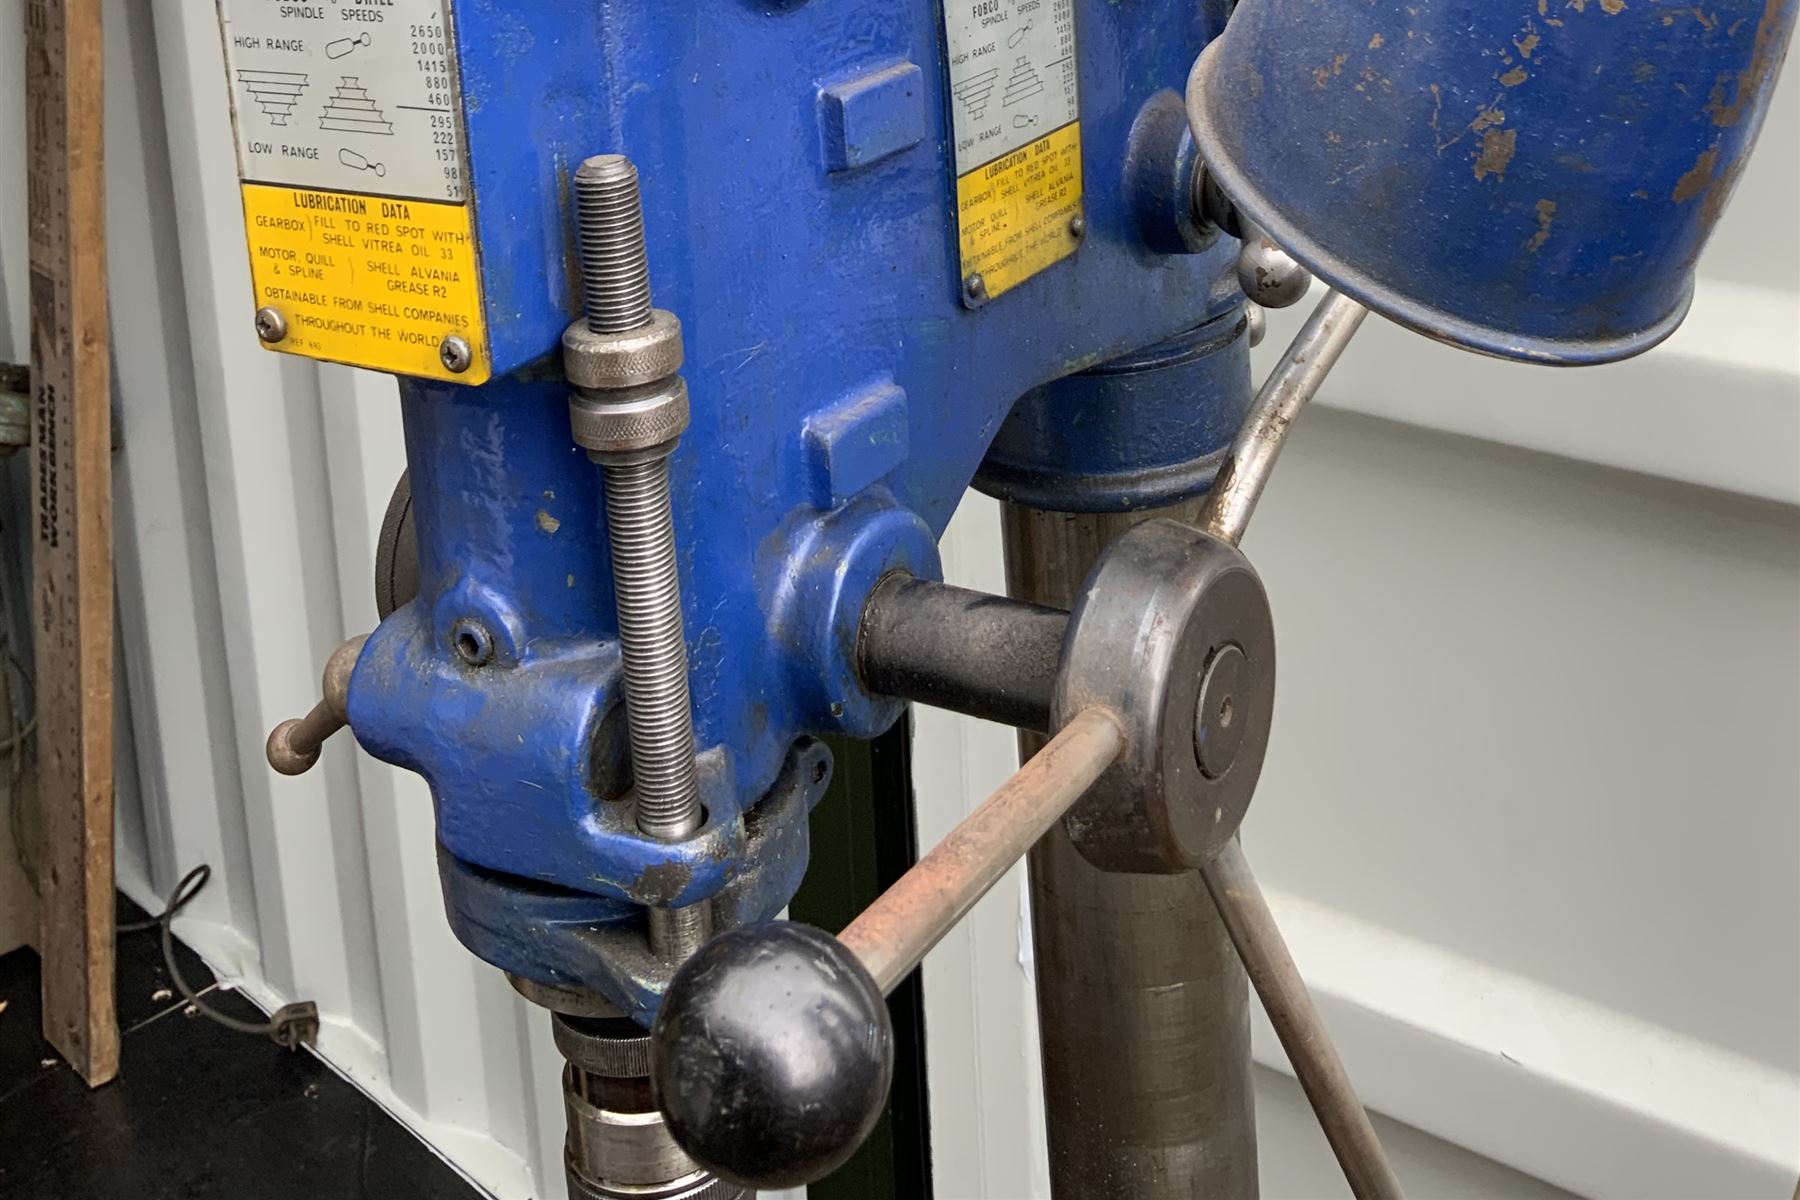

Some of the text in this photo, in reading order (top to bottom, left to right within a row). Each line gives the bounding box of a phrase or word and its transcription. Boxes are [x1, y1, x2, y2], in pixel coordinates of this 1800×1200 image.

[280, 6, 384, 22] SPINDLE SPEEDS
[973, 0, 999, 19] FOBCO
[982, 0, 1040, 28] SPINDLE SPEEDS
[410, 25, 442, 38] 2650
[234, 36, 304, 52] HIGH RANGE
[412, 42, 444, 55] 2000
[952, 42, 996, 66] HIGH RANGE
[417, 60, 446, 73] 1415
[426, 76, 448, 89] 880
[428, 93, 450, 106] 460
[430, 116, 452, 129] 295
[433, 132, 454, 145] 222
[959, 124, 1002, 152] LOW RANGE
[248, 142, 320, 160] LOW RANGE
[436, 148, 456, 161] 157
[985, 139, 1050, 180] LUBRICATION DATA
[444, 167, 458, 179] 98
[996, 176, 1009, 188] FILL
[1015, 168, 1023, 179] TO
[1026, 161, 1039, 173] RED
[446, 185, 459, 197] 51
[293, 192, 411, 220] LUBRICATION DATA
[255, 215, 464, 245] GEARBOX FILL TO RED SPOT WITH
[323, 233, 453, 260] SHELL VITREA OIL 33
[306, 252, 335, 267] QUILL
[273, 263, 324, 280] & SPLINE
[367, 261, 461, 283] SHELL ALVANIA
[387, 280, 447, 299] GREASE R2
[265, 286, 469, 328] OBTAINABLE FROM SHELL COMPANIES
[295, 314, 439, 347] THROUGHOUT THE WORLD
